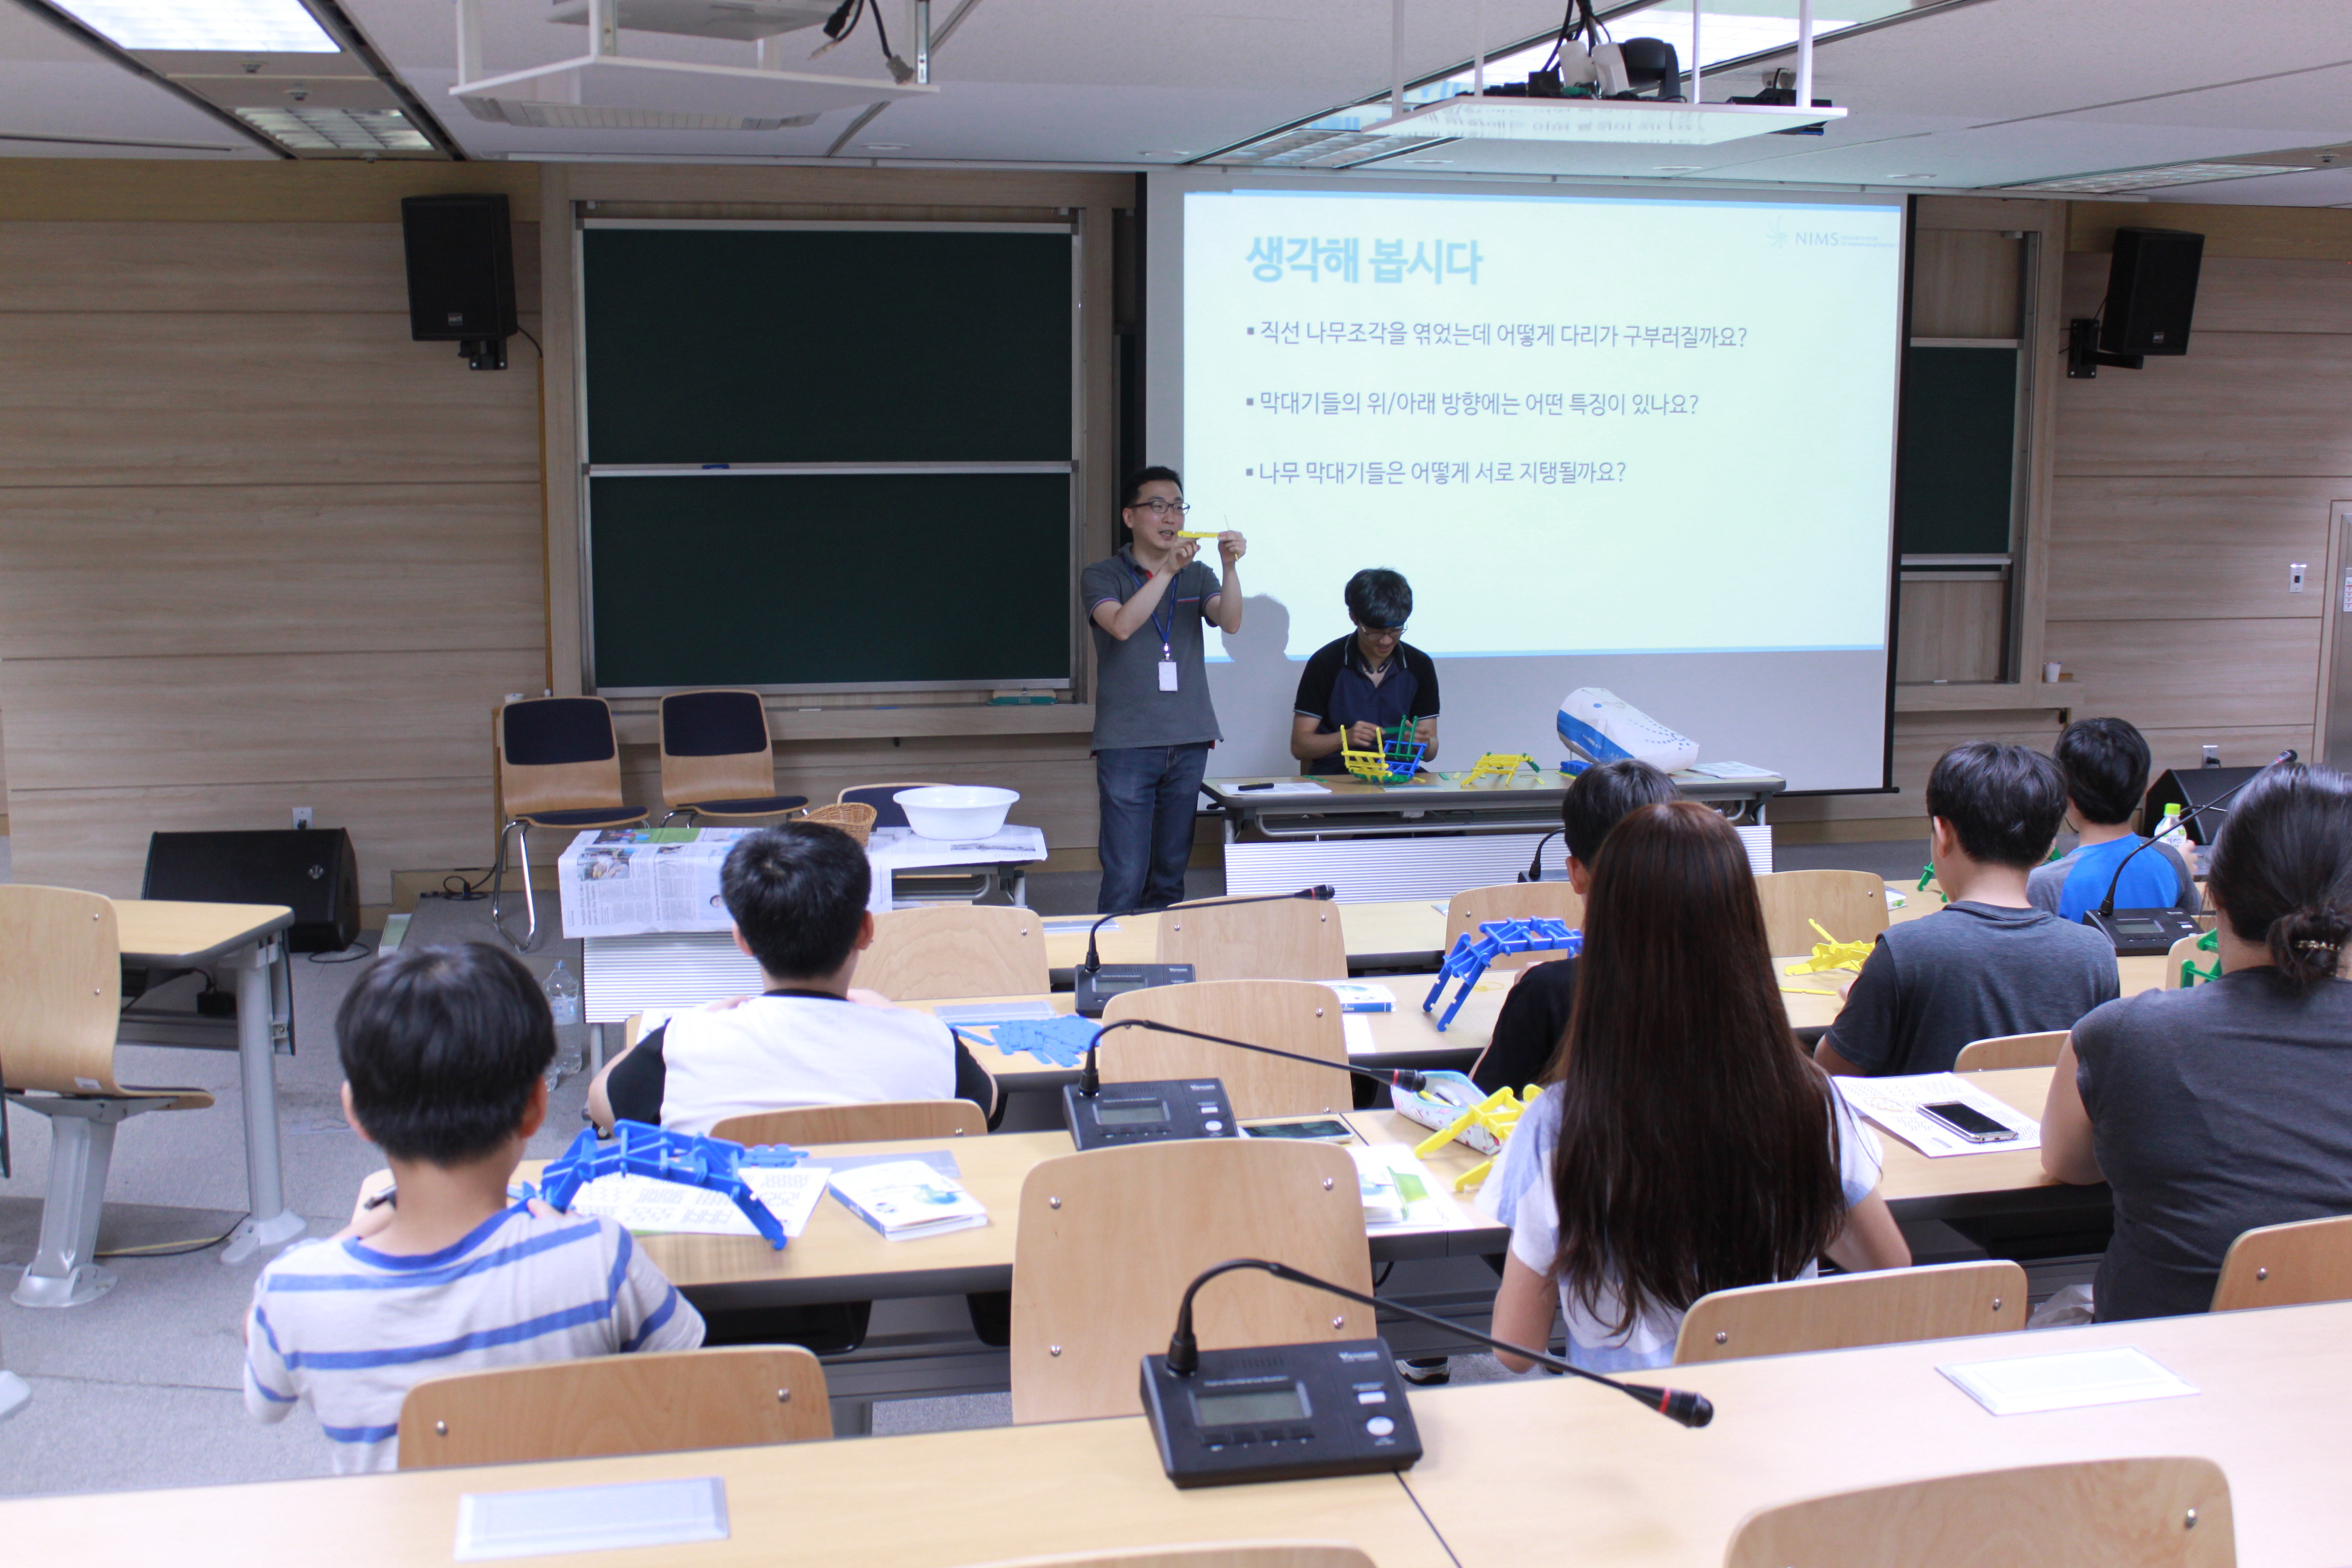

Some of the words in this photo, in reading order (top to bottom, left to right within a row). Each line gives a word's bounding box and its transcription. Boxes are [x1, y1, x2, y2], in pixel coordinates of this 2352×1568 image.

[1795, 232, 1839, 246] NIMS
[1246, 236, 1359, 284] 생각해
[1371, 238, 1484, 286] 봅시다
[1261, 321, 1300, 344] 직선
[1307, 321, 1408, 345] 나무조각을
[1413, 322, 1491, 346] 엮었는데
[1497, 323, 1555, 347] 어떻게
[1561, 324, 1618, 347] 다리가
[1623, 325, 1748, 348] 구부러질까요?
[1261, 392, 1361, 415] 막대기들의
[1368, 392, 1436, 415] 위/아래
[1442, 391, 1521, 416] 방향에는
[1526, 392, 1564, 416] 어떤
[1569, 393, 1625, 416] 특징이
[1632, 393, 1699, 416] 있나요?
[1260, 461, 1301, 485] 나무
[1306, 461, 1407, 485] 막대기들은
[1412, 461, 1470, 485] 어떻게
[1475, 461, 1515, 484] 서로
[1520, 461, 1626, 485] 지탱될까요?
